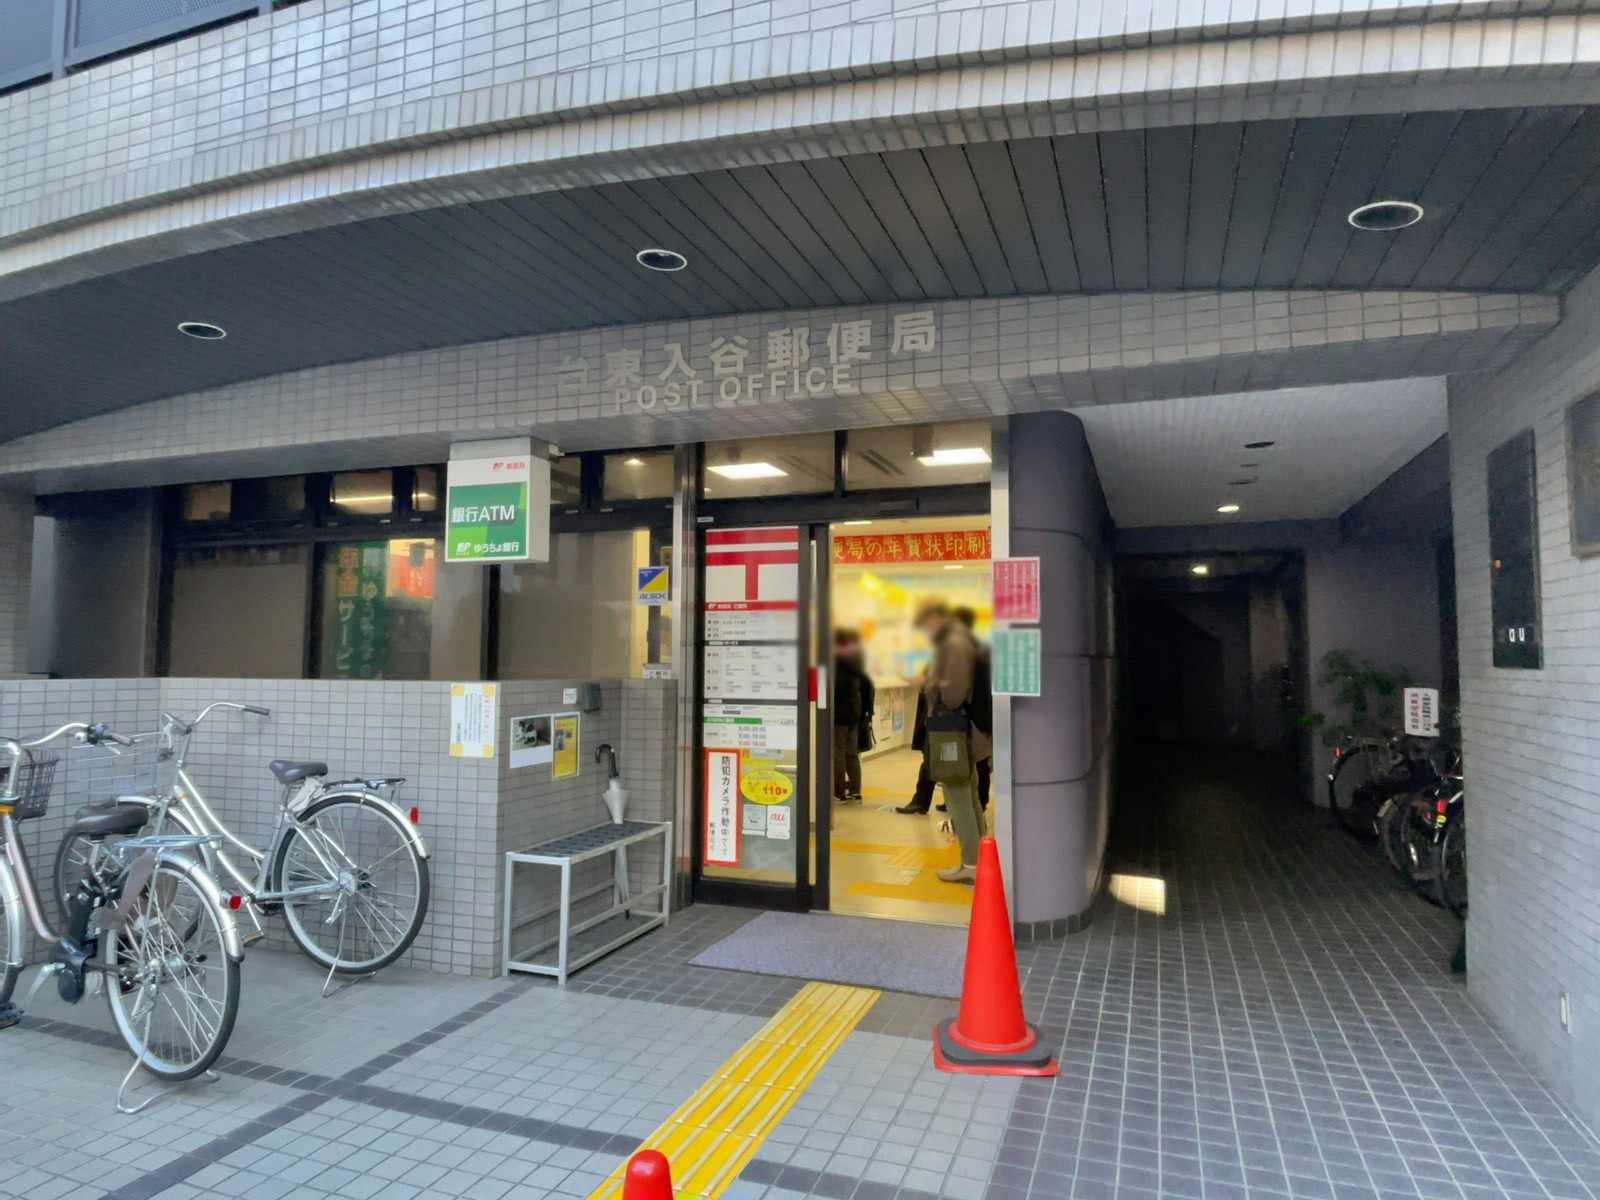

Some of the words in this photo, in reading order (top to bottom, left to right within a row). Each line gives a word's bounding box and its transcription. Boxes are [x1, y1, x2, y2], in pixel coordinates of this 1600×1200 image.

[556, 310, 936, 392] 台東入谷郵便局
[615, 379, 703, 411] POST
[719, 362, 851, 402] OFFICE
[451, 504, 515, 523] 銀行ATM
[474, 541, 520, 554] ゆうちょ銀行
[833, 534, 990, 561] 便局の年賀状印刷
[639, 592, 667, 600] ALSOK
[720, 755, 731, 856] 防犯カメラ作動中です
[770, 813, 786, 821] au
